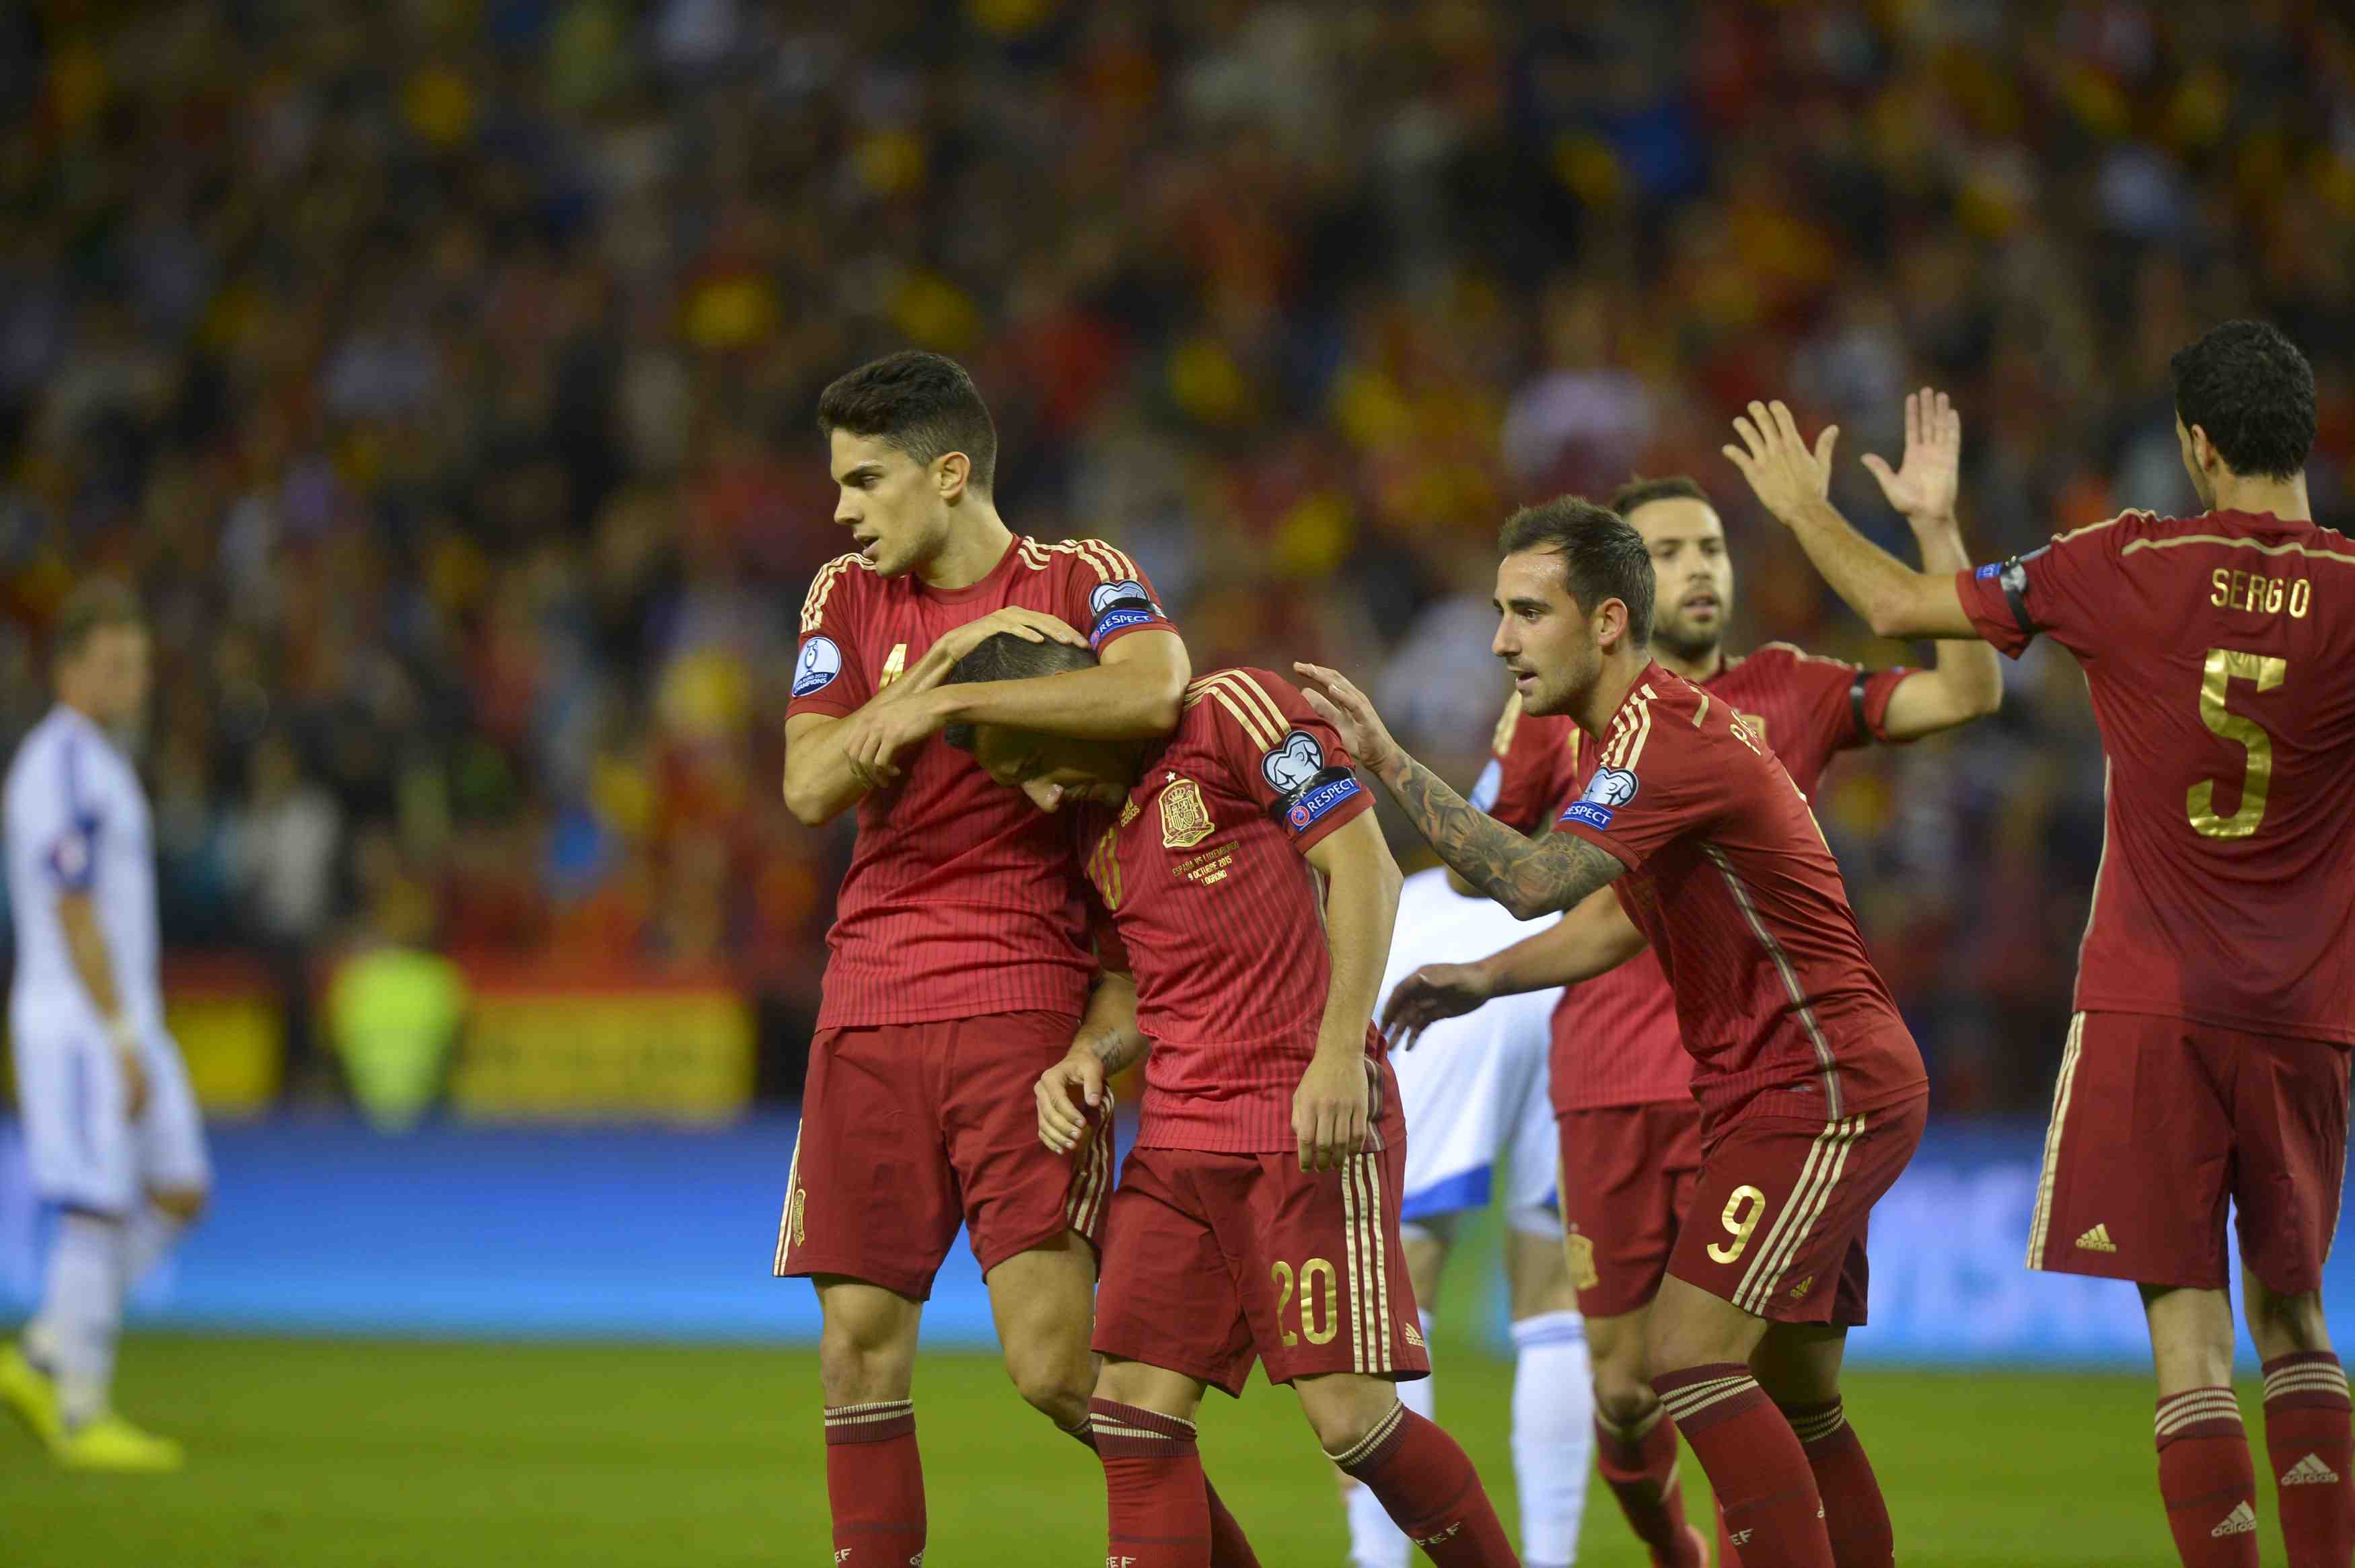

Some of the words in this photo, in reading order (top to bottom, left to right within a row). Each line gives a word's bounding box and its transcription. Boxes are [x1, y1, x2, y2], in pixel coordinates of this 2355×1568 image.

[2210, 568, 2311, 619] SERGIO
[1099, 615, 1149, 632] RESPECT
[2186, 647, 2288, 837] 5
[1307, 778, 1354, 813] RESPECT
[1187, 872, 1194, 881] 9
[1192, 861, 1217, 879] OCTUBRE
[1218, 855, 1233, 868] 2015
[1706, 1185, 1766, 1264] 9
[2075, 1238, 2117, 1253] adidas
[1270, 1258, 1338, 1345] 20
[2211, 1518, 2257, 1538] adida
